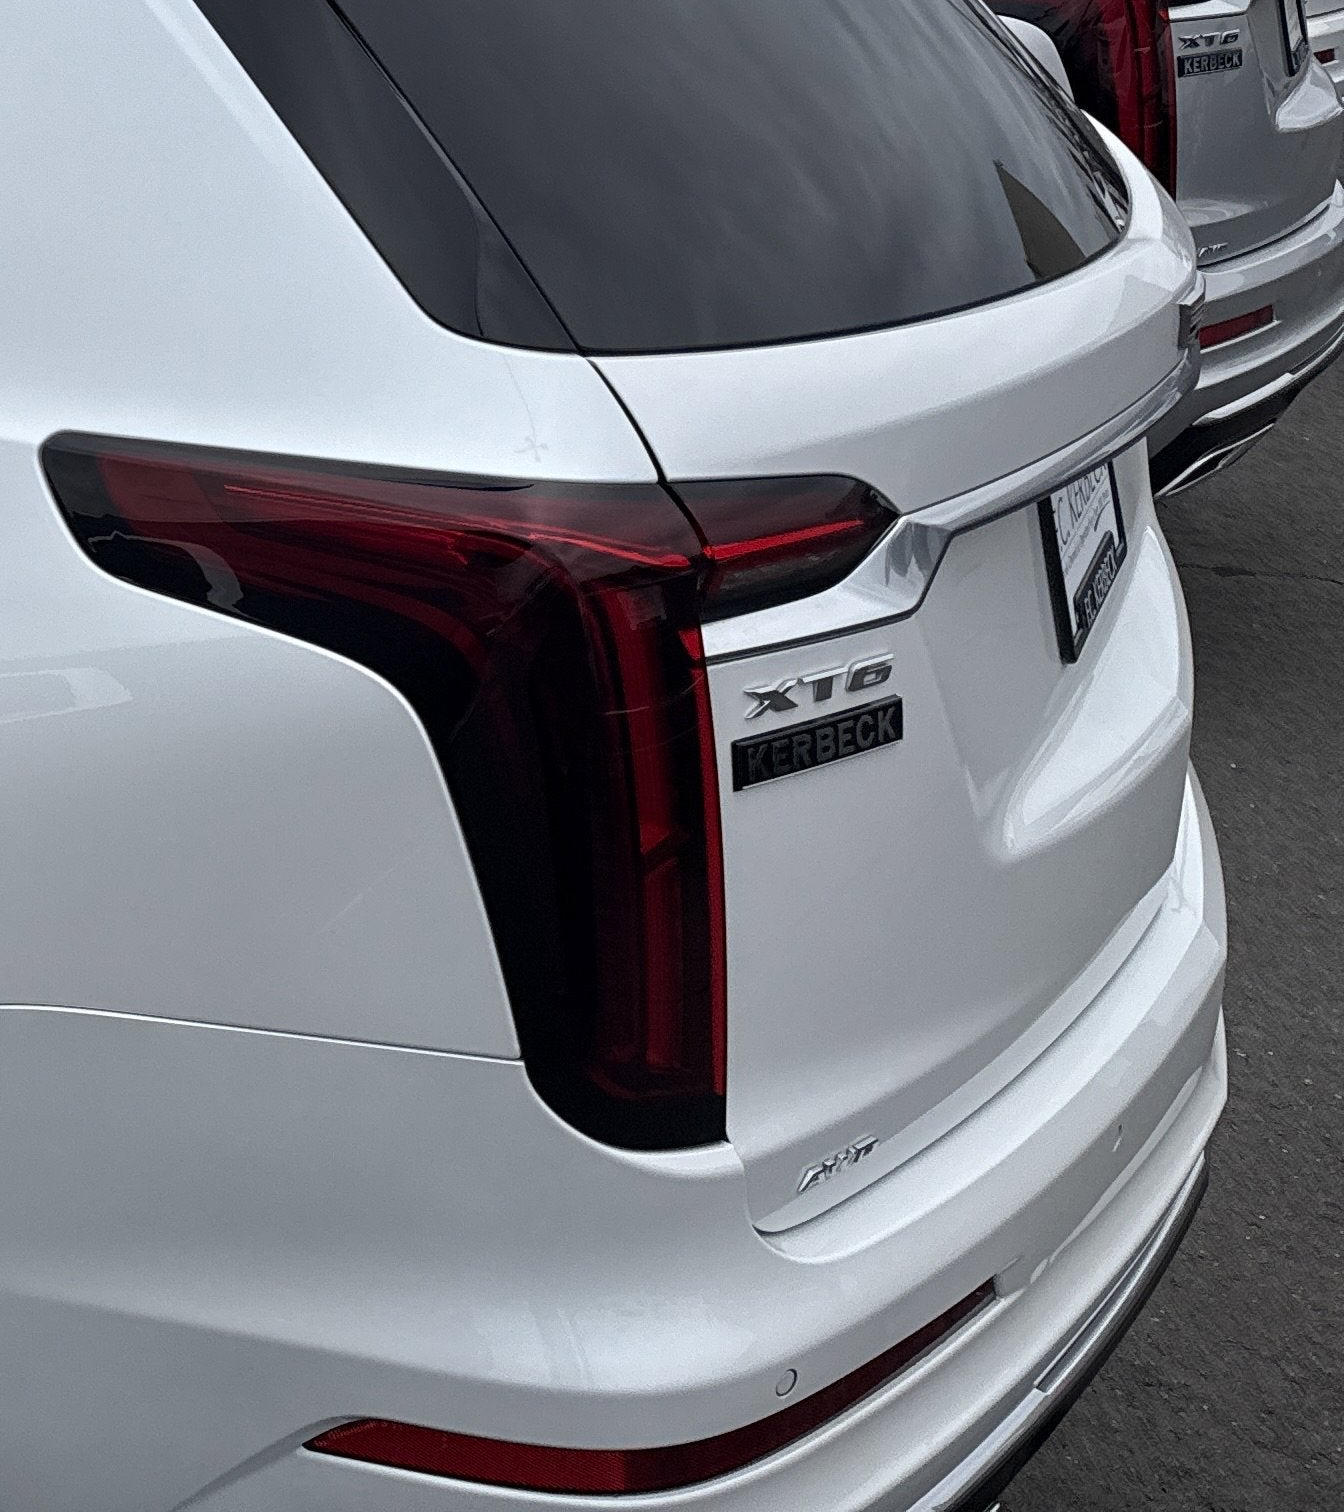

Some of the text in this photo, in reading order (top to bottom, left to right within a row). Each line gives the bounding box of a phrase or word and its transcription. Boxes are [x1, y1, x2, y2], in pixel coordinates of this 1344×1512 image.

[1178, 29, 1240, 50] XT6
[1184, 51, 1241, 73] KERBECK
[743, 651, 895, 720] XT6
[746, 705, 896, 781] KERBECK
